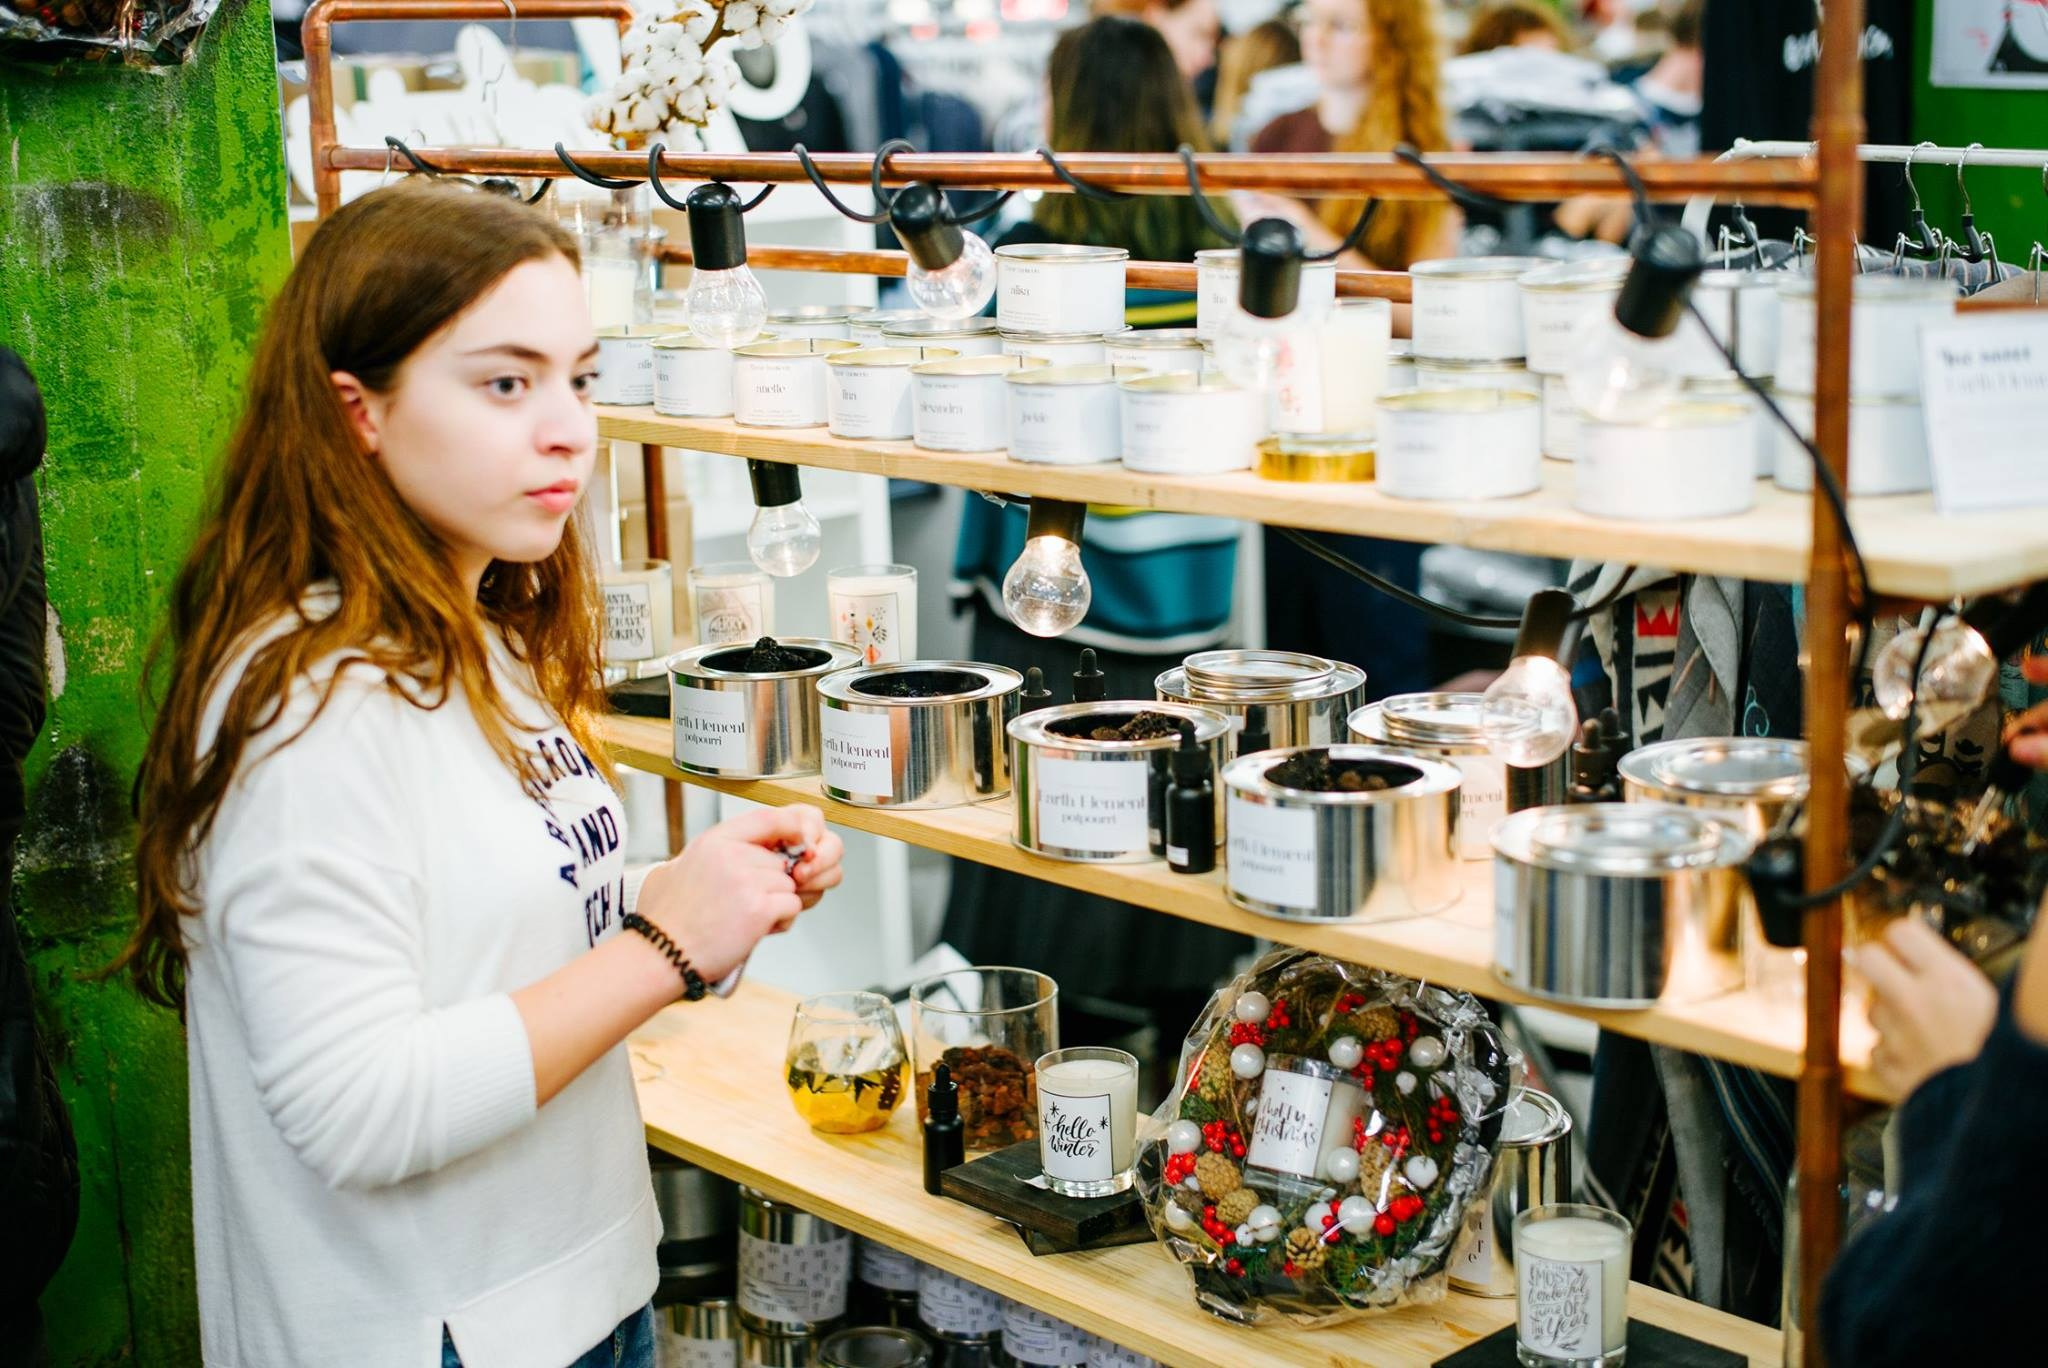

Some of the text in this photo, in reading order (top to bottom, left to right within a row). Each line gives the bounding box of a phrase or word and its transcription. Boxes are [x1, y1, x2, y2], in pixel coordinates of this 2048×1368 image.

[606, 593, 636, 605] ANTA,
[684, 732, 722, 746] potpourri
[830, 756, 867, 771] potpourri
[1051, 1113, 1096, 1141] hello
[1048, 1134, 1099, 1158] winter
